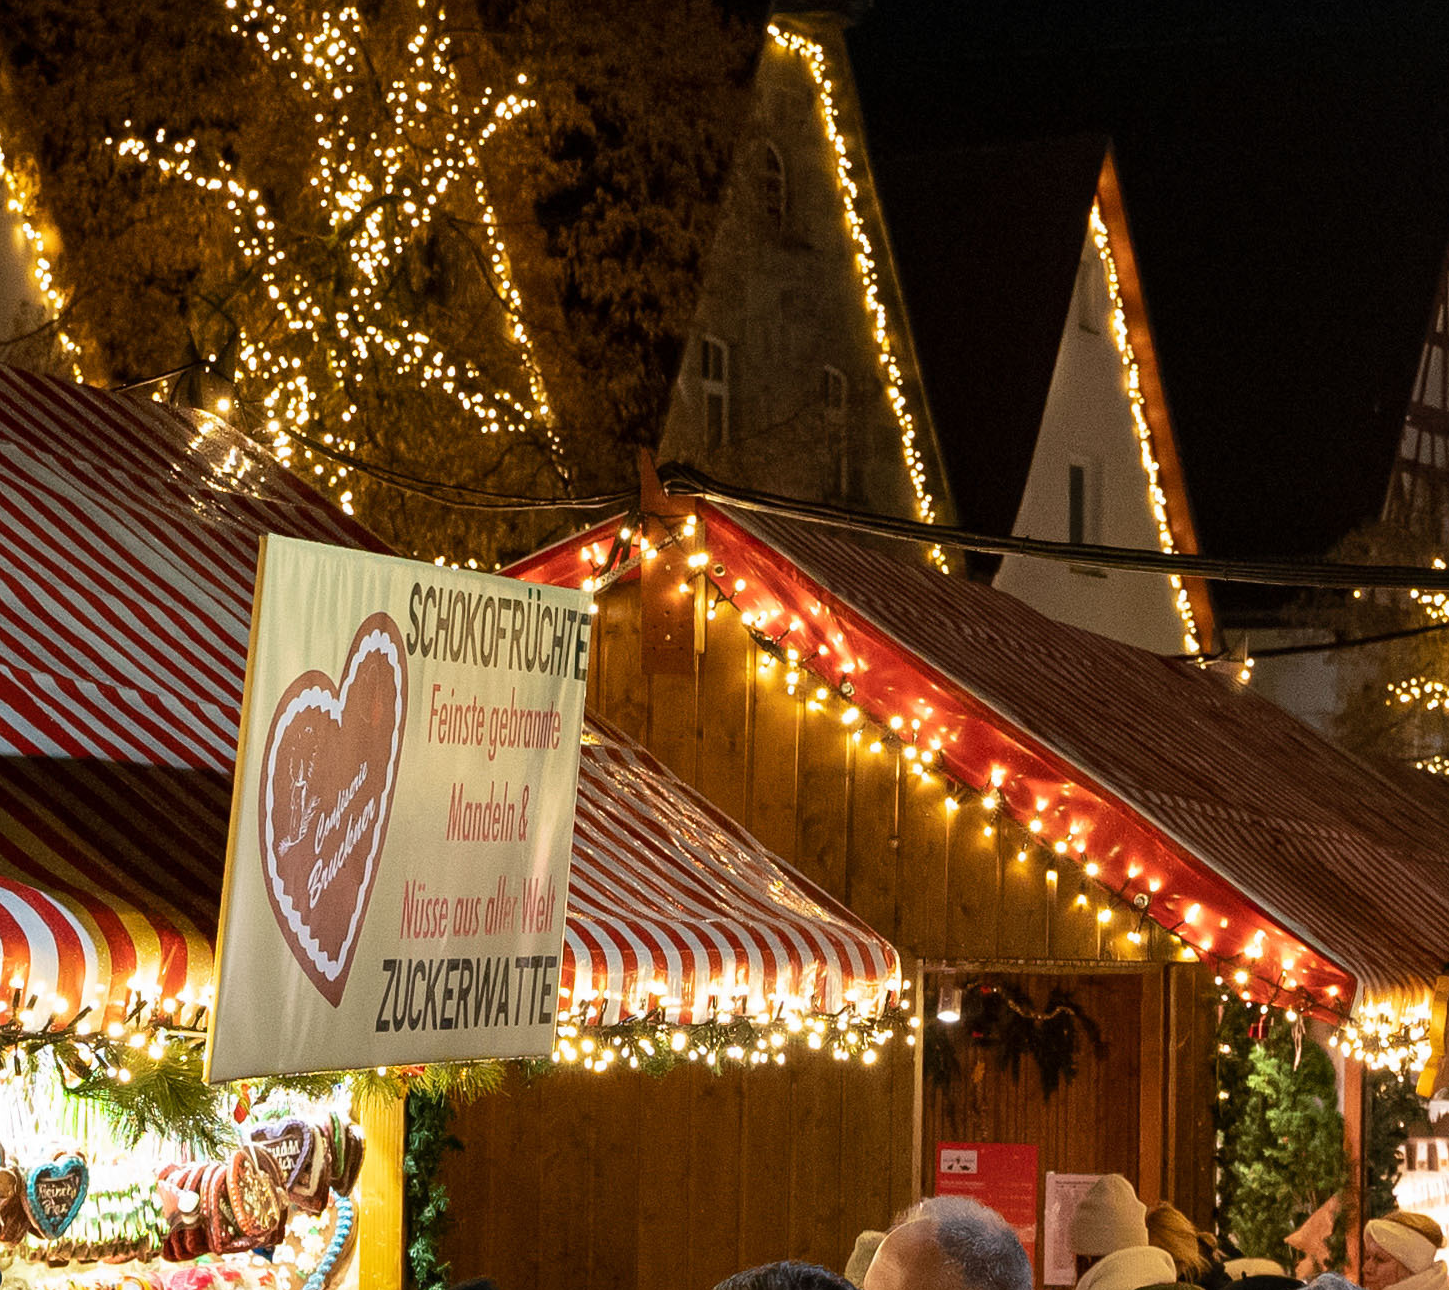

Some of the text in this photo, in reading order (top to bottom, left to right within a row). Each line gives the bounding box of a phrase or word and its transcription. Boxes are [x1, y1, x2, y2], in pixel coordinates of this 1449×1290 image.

[406, 582, 590, 680] SCHOKOFRÜCHTE
[428, 683, 562, 761] Feinste gebrannte
[446, 782, 530, 843] Mandeln &
[399, 875, 556, 940] Nüsse aus aller Welt
[374, 955, 558, 1033] ZUCKERWATTE
